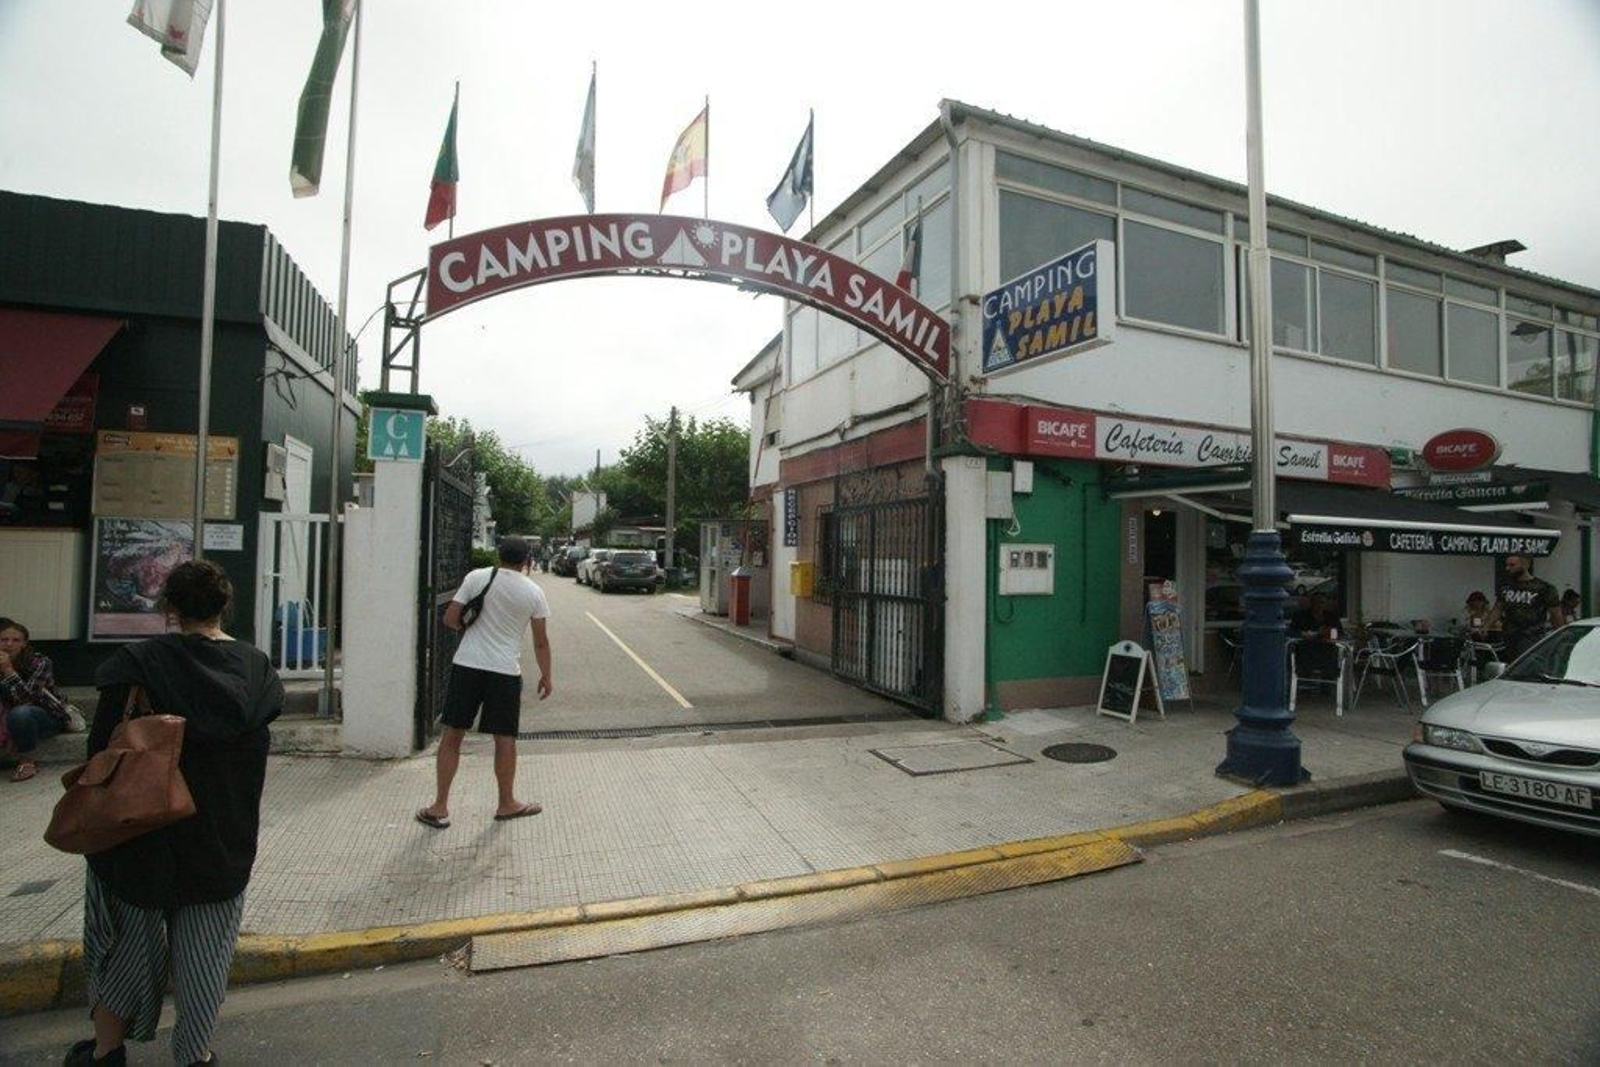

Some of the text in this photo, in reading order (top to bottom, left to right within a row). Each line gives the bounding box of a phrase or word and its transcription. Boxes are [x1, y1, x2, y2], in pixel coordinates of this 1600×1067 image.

[438, 221, 942, 362] CAMPING PLAYA SAMIL
[984, 250, 1096, 319] CAMPING
[1008, 286, 1084, 336] PLAYA
[1016, 312, 1096, 360] SAMIL
[386, 414, 408, 440] C
[1105, 423, 1185, 458] Cafetería
[1276, 445, 1321, 469] Samil
[1301, 530, 1361, 545] Estrella Galicia
[1480, 537, 1509, 554] PLAYA
[1510, 538, 1524, 553] DE
[1525, 539, 1550, 555] SAMIL
